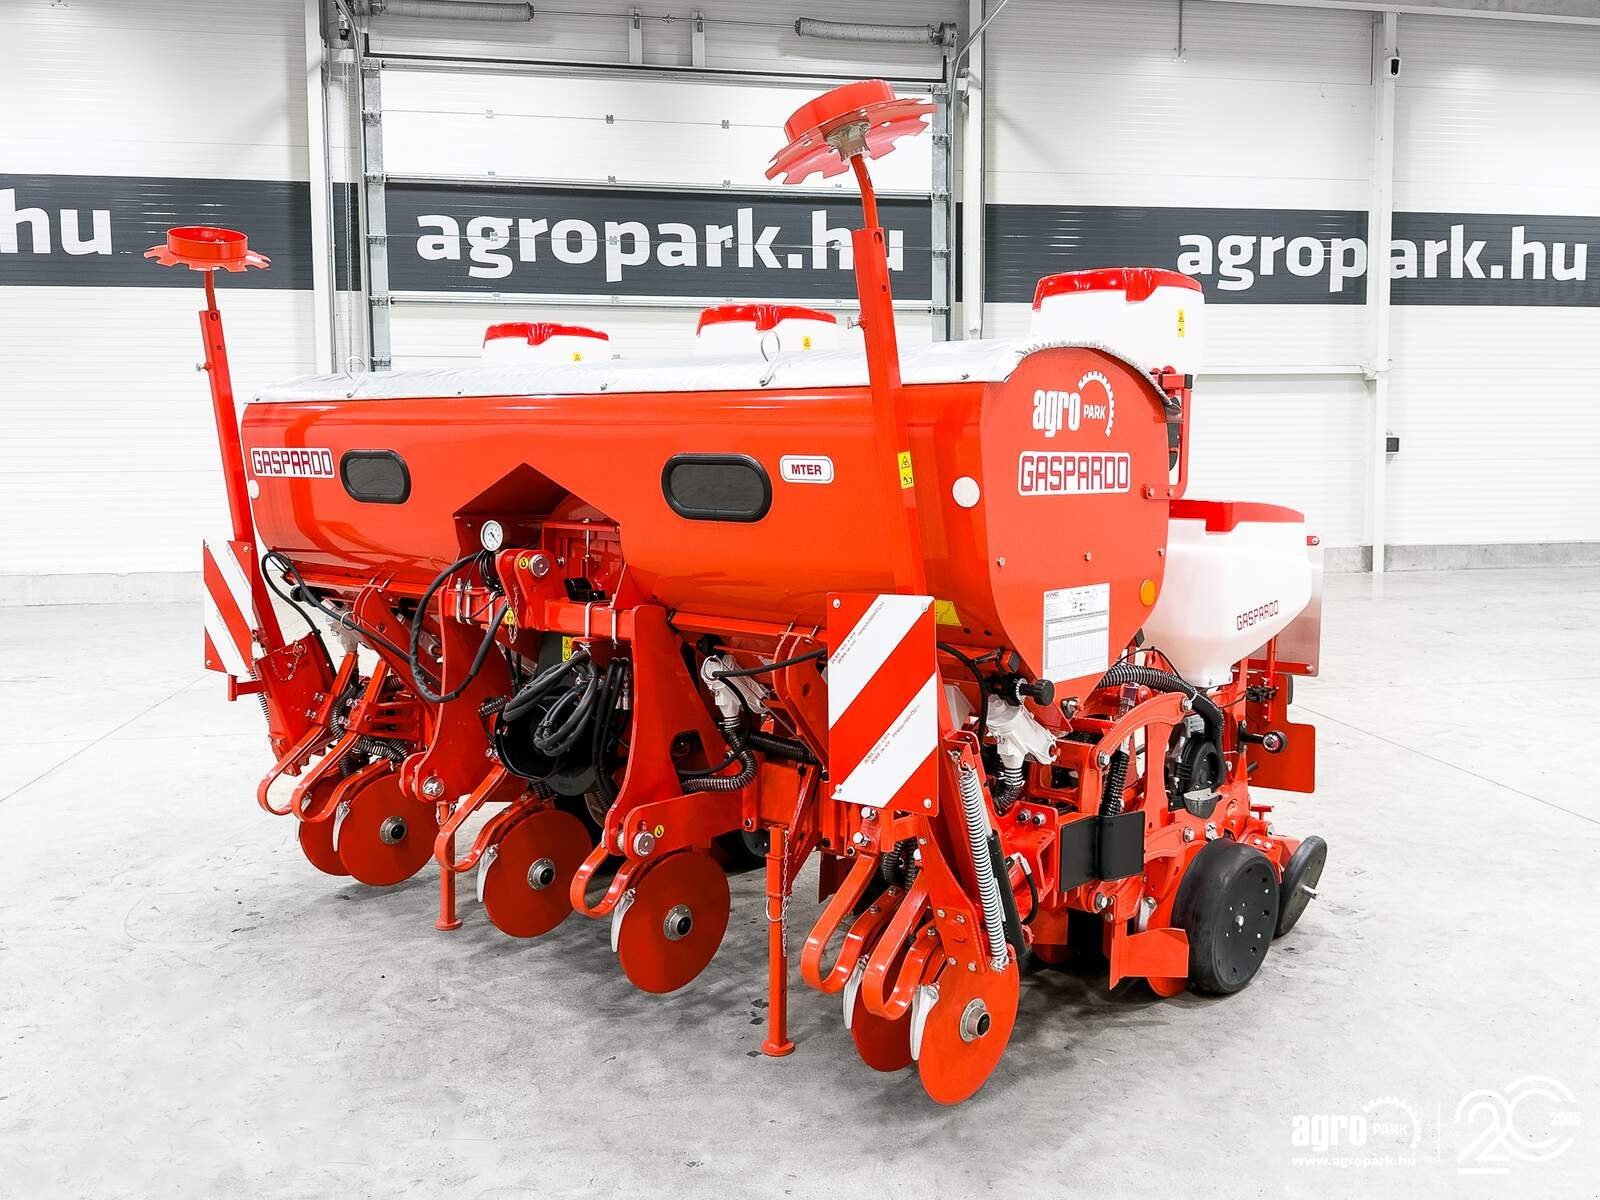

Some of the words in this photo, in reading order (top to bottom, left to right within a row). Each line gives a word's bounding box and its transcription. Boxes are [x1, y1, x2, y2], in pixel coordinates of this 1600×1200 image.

[1177, 224, 1588, 293] agropark.hu
[1032, 389, 1081, 438] agro
[1083, 404, 1106, 420] PARK
[251, 450, 334, 476] GASPARDO
[791, 464, 822, 476] MTER
[1020, 455, 1129, 492] GASPARDO
[1236, 599, 1279, 631] GASPARDO
